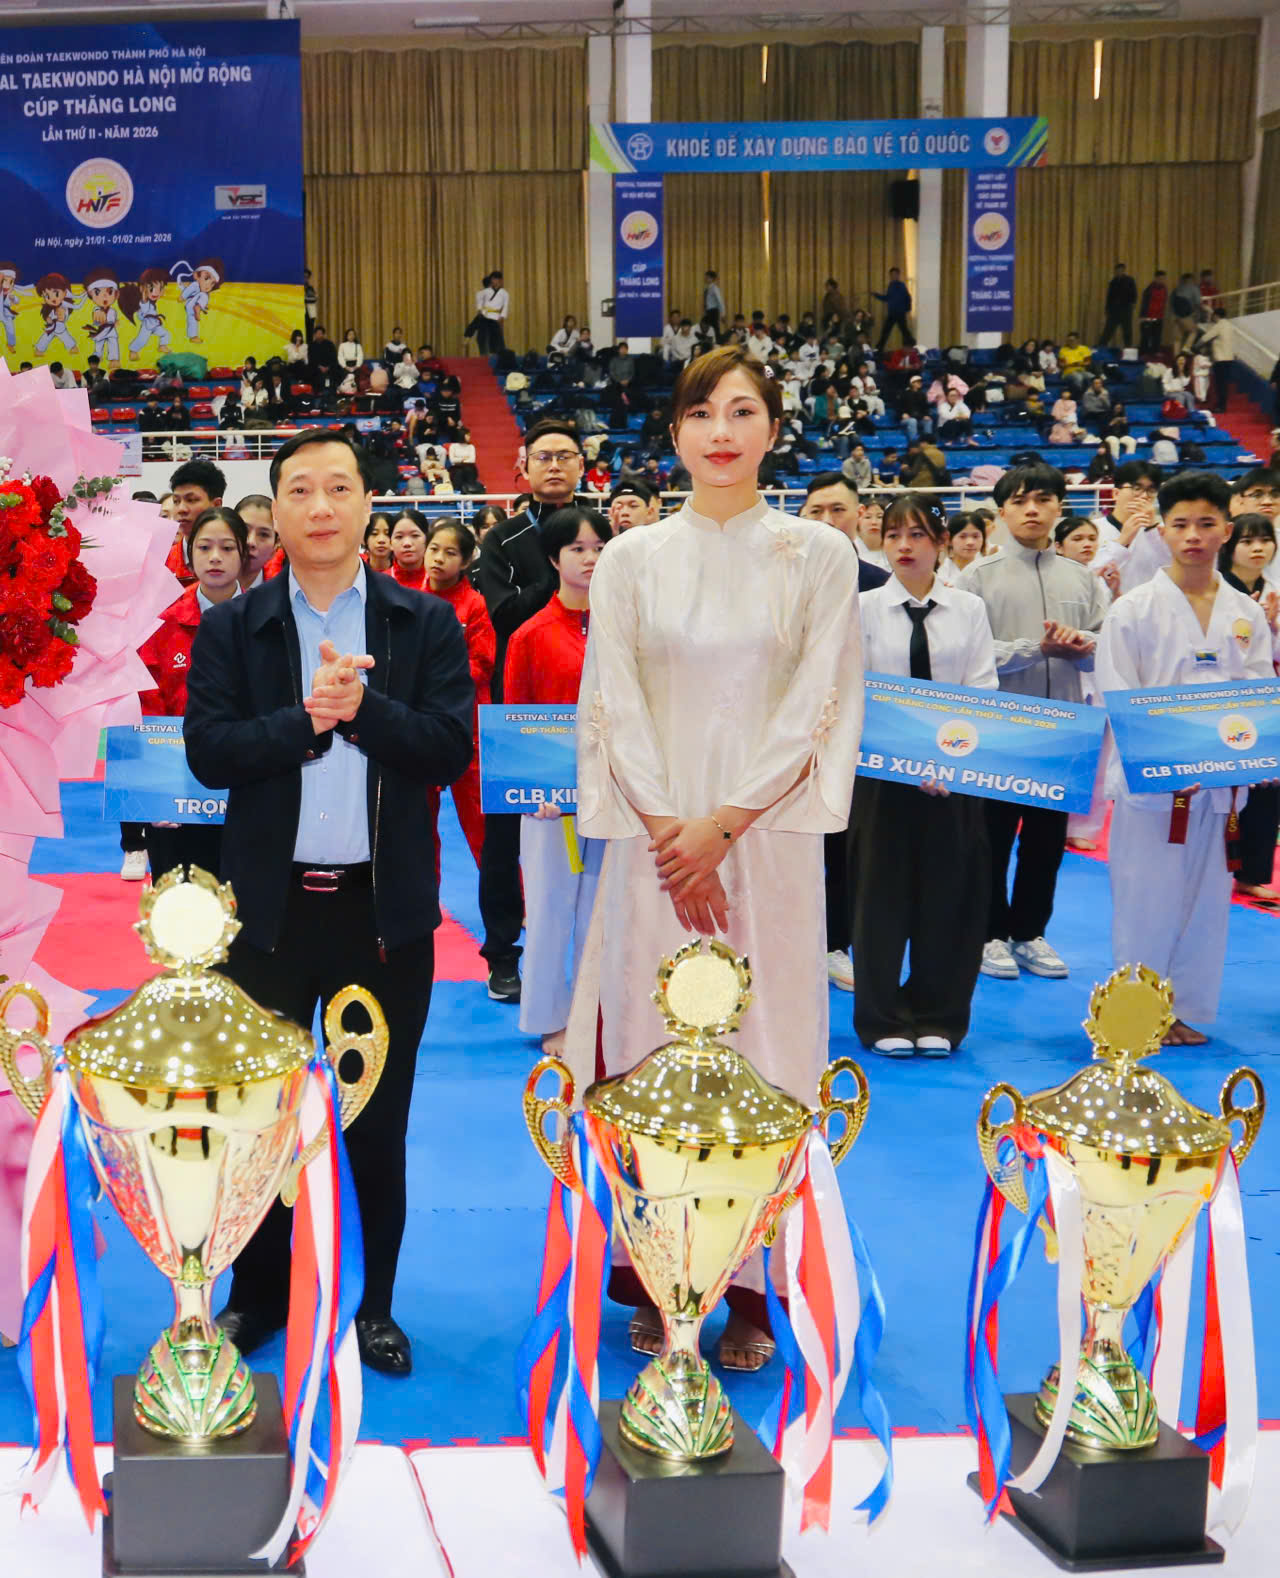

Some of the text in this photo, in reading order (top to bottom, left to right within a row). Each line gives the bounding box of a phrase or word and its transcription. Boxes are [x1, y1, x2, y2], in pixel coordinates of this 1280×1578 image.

[16, 52, 43, 64] ĐOÀN
[46, 51, 109, 63] TAEKWONDO
[111, 48, 145, 60] THÀNH
[148, 45, 169, 58] PHỐ
[188, 45, 206, 59] NỘI
[22, 70, 119, 89] TAEKWONDO
[123, 65, 145, 85] HÀ
[149, 64, 176, 88] NỘI
[180, 61, 204, 83] MỞ
[208, 62, 252, 87] RỘNG
[23, 94, 177, 117] CÚP THĂNG LONG
[42, 125, 63, 141] LẦN
[65, 125, 86, 140] THỨ
[104, 125, 130, 138] NĂM
[132, 126, 159, 138] 2026
[781, 136, 828, 160] DỰNG
[873, 131, 894, 158] VỆ
[925, 130, 970, 154] QUỐC
[35, 238, 45, 247] Hà
[64, 238, 83, 249] ngày
[85, 236, 106, 245] 31/01
[112, 235, 133, 244] 01/02
[134, 234, 152, 243] năm
[154, 233, 172, 242] 2026
[865, 680, 1076, 719] ESTIVAL TAEKWONDO HÀ NỘI MỞ RỘNG
[1130, 695, 1174, 705] FESTIVAL
[1176, 690, 1239, 702] TAEKWONDO
[134, 724, 178, 733] FESTIVAL
[856, 751, 1065, 801] LB XUÂN PHƯƠNG
[1142, 757, 1278, 778] CLB TRƯỜNG THCS
[505, 788, 545, 804] CLB
